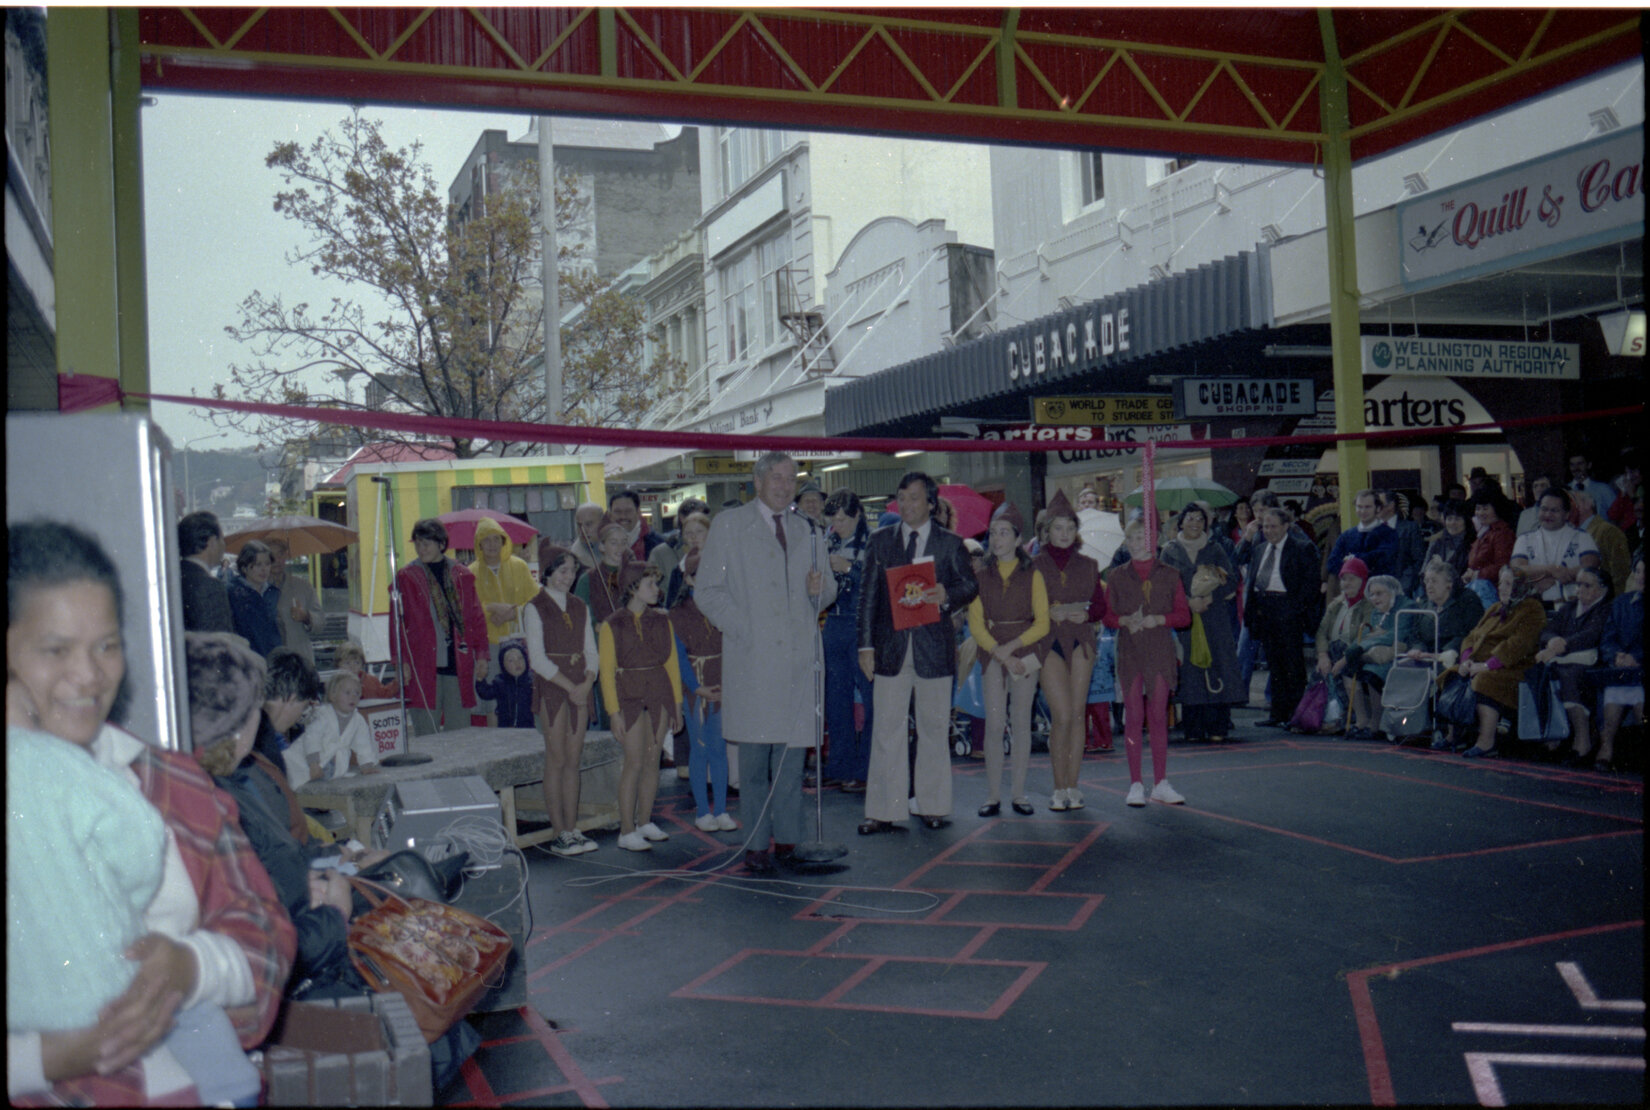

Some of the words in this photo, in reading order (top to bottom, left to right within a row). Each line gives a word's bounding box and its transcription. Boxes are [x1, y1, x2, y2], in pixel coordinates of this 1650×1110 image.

[1441, 200, 1455, 213] THE
[1452, 186, 1531, 249] Quill
[1537, 184, 1564, 228] &
[1577, 158, 1645, 213] Ca
[1008, 308, 1130, 380] CUBACADE
[1394, 341, 1493, 358] WELLINGTON
[1499, 345, 1571, 361] REGIONAL
[1395, 357, 1474, 373] PLANNING
[1481, 360, 1566, 374] AUTHORITY
[1199, 382, 1300, 405] CUBACADE
[1069, 399, 1106, 409] WORLD
[1115, 399, 1149, 409] TRADE
[1364, 390, 1466, 426] arters
[740, 408, 759, 428] Bank
[1091, 412, 1105, 421] TO
[1112, 411, 1153, 421] STURDEE
[983, 424, 1093, 441] arters
